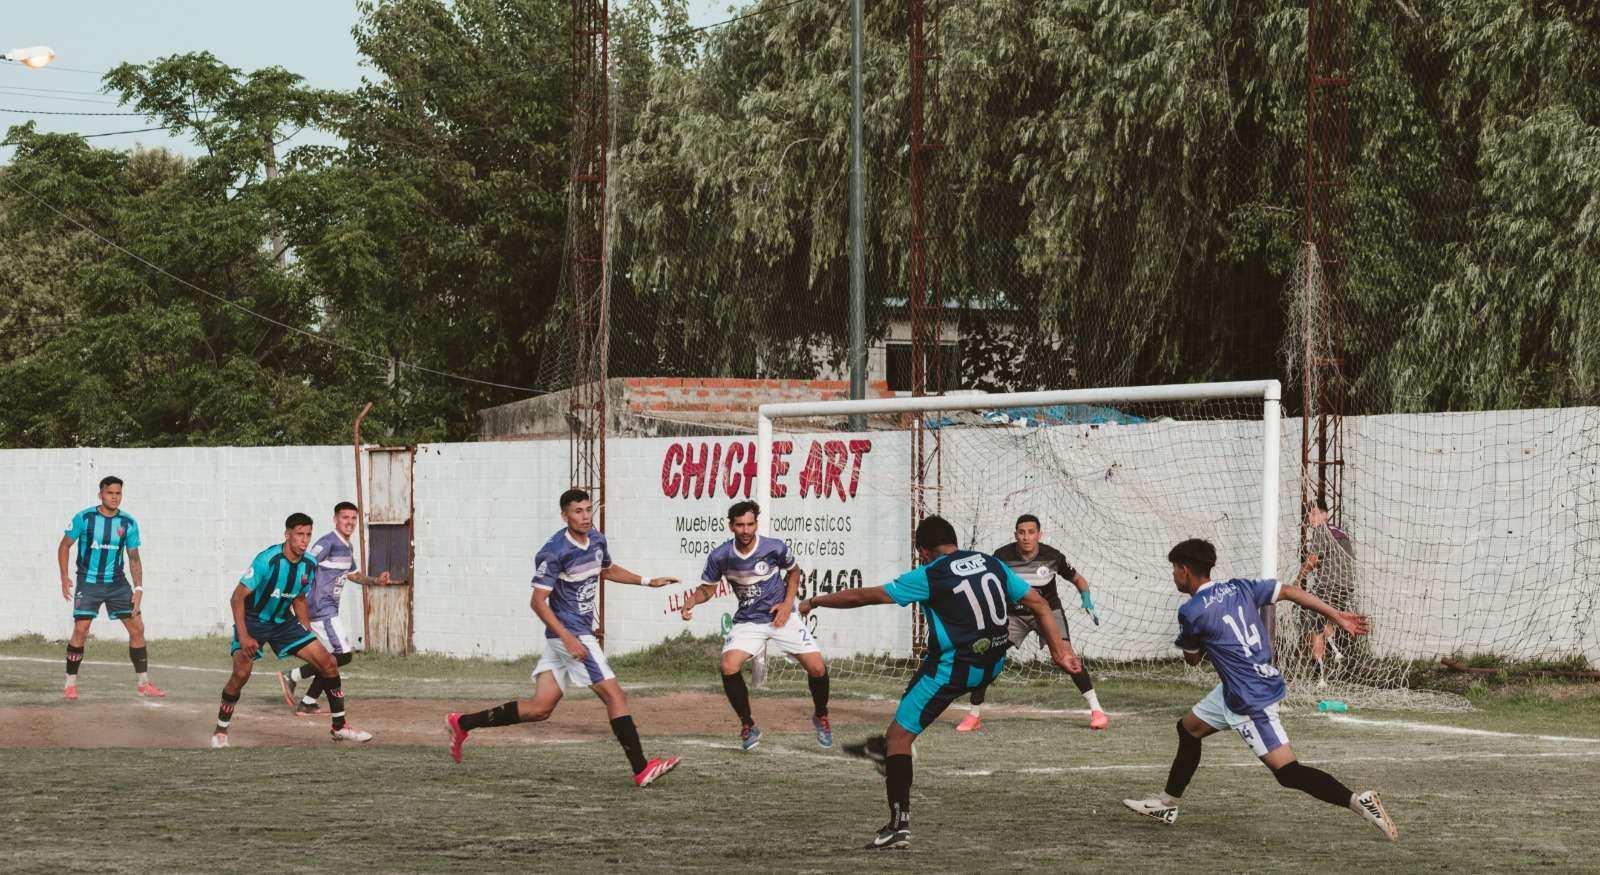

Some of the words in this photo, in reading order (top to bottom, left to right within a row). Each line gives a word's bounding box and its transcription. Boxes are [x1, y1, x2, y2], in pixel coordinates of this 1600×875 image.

[661, 441, 792, 499] CHICHE
[799, 440, 872, 502] ART
[675, 515, 725, 532] Muebles
[770, 514, 852, 532] rodomesticos
[785, 538, 845, 556] Bicicletas
[952, 572, 1008, 630] 10
[1222, 605, 1262, 658] 14
[1359, 795, 1382, 818] NIKE
